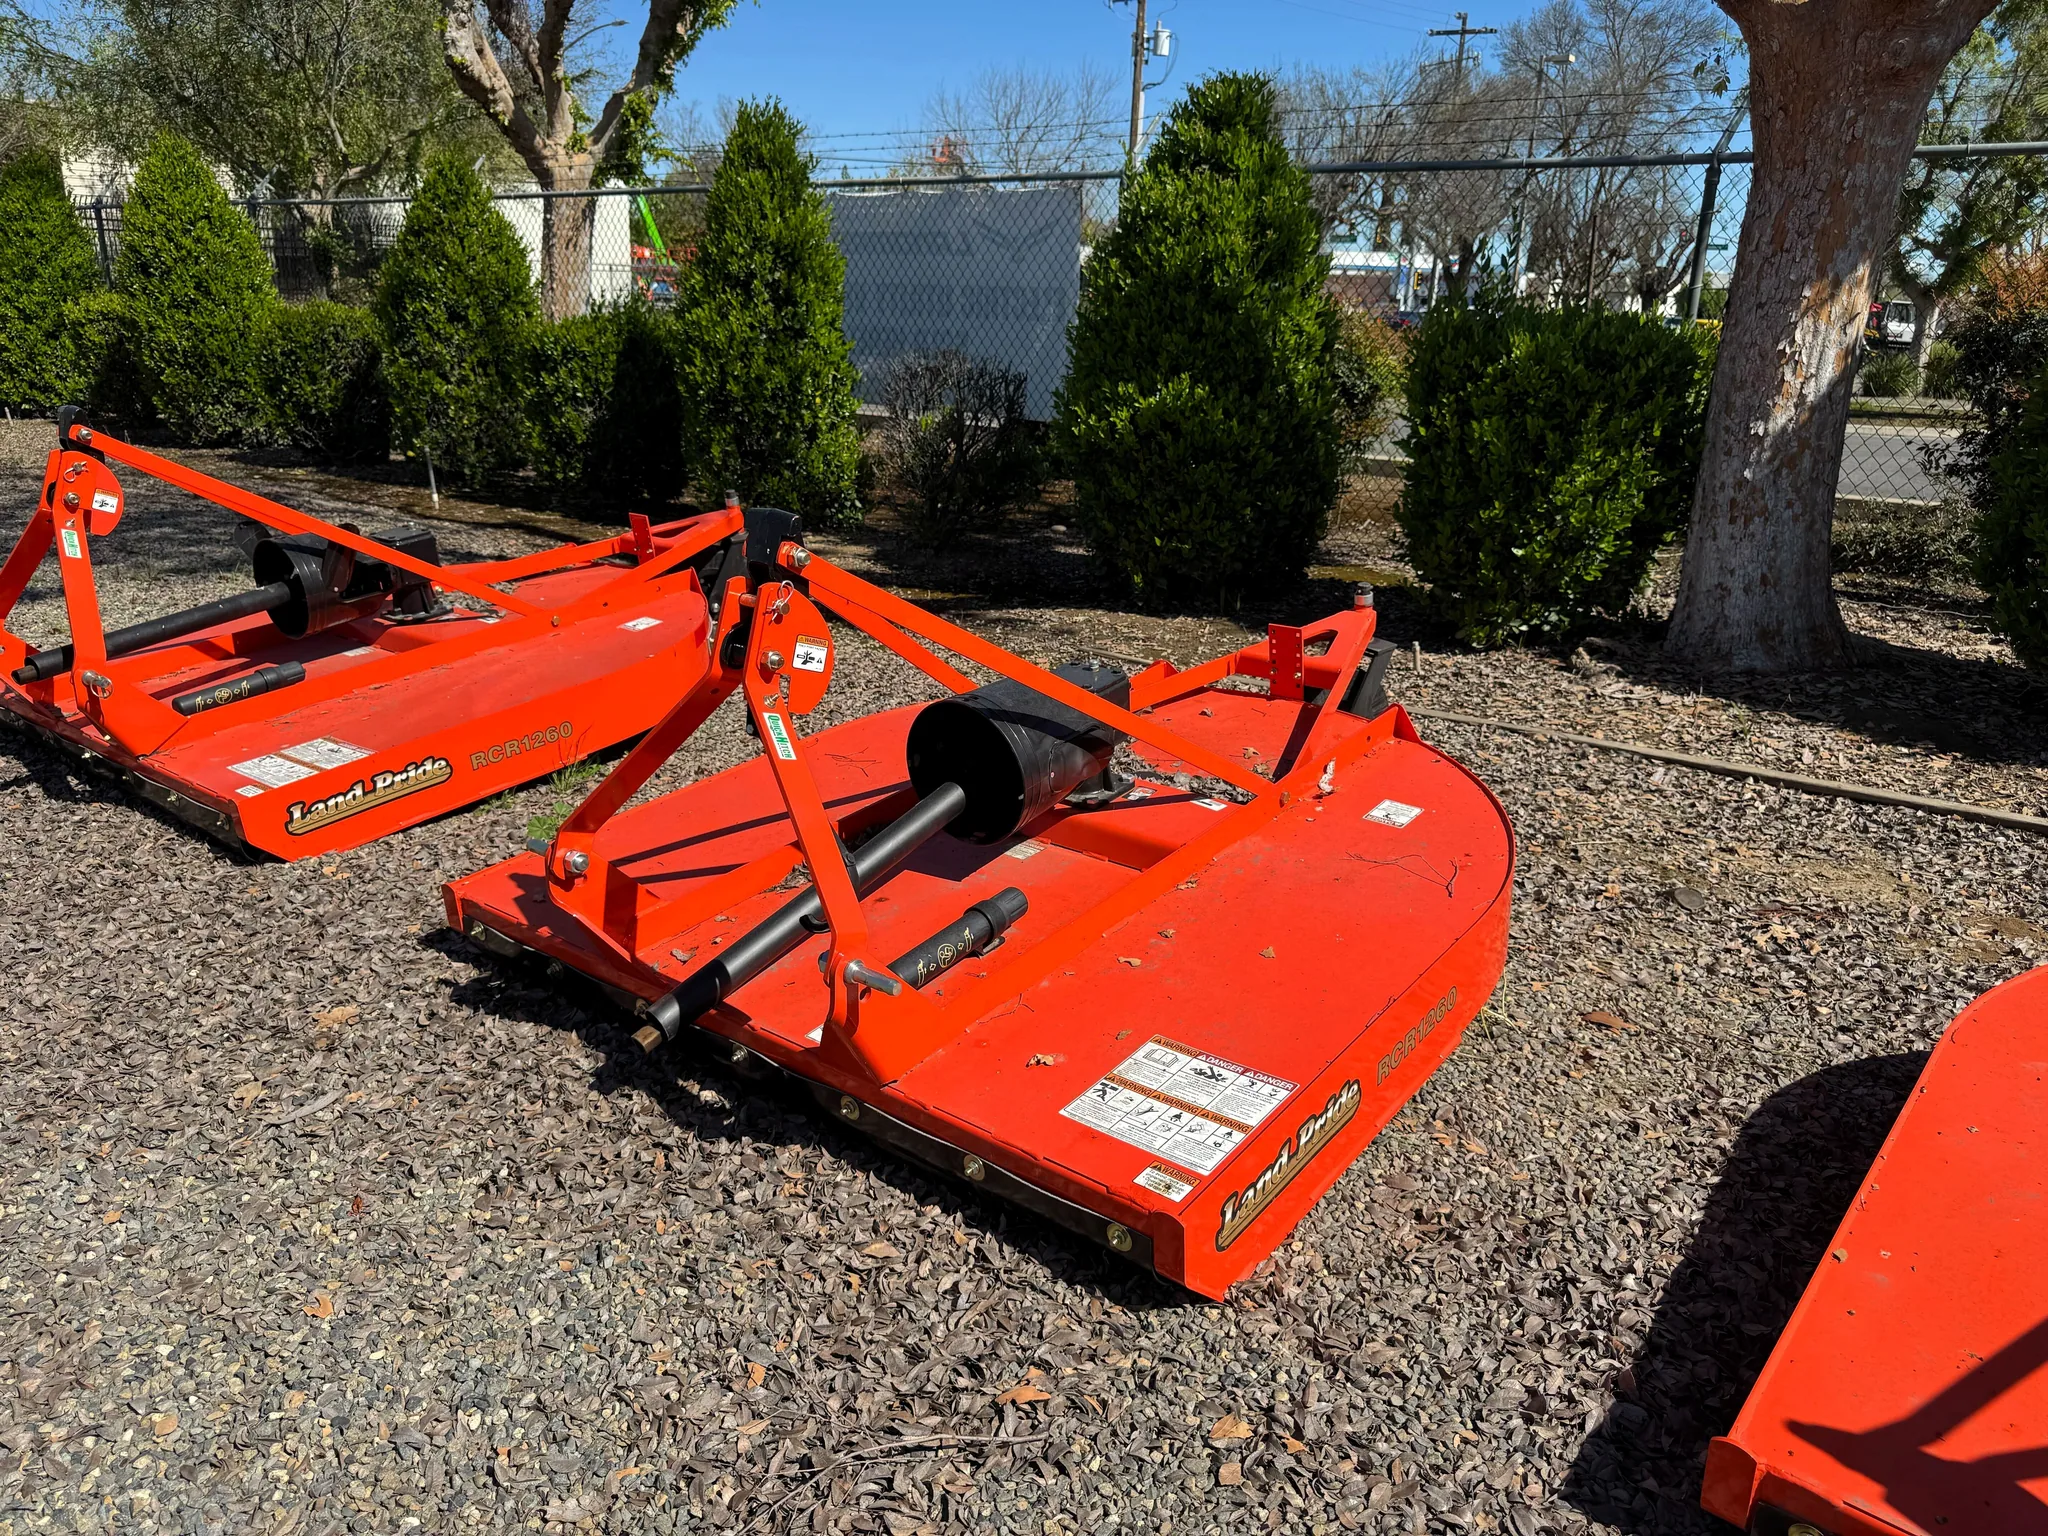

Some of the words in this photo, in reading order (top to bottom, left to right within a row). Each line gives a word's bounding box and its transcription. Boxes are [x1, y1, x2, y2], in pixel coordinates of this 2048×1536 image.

[804, 636, 827, 646] WARNING
[470, 721, 573, 770] RCR1260
[289, 781, 365, 829] Land
[373, 758, 449, 797] Pride
[1377, 985, 1457, 1086] RCR1260
[1161, 1039, 1199, 1056] WARNING
[1205, 1055, 1245, 1073] DANGER
[1113, 1077, 1153, 1095] WARNING
[1252, 1071, 1295, 1090] DANGER
[1159, 1094, 1200, 1114] WARNING
[1208, 1113, 1250, 1133] WARNING
[1221, 1139, 1291, 1239] Land
[1296, 1080, 1360, 1160] Pride
[1162, 1167, 1196, 1185] WARNING
